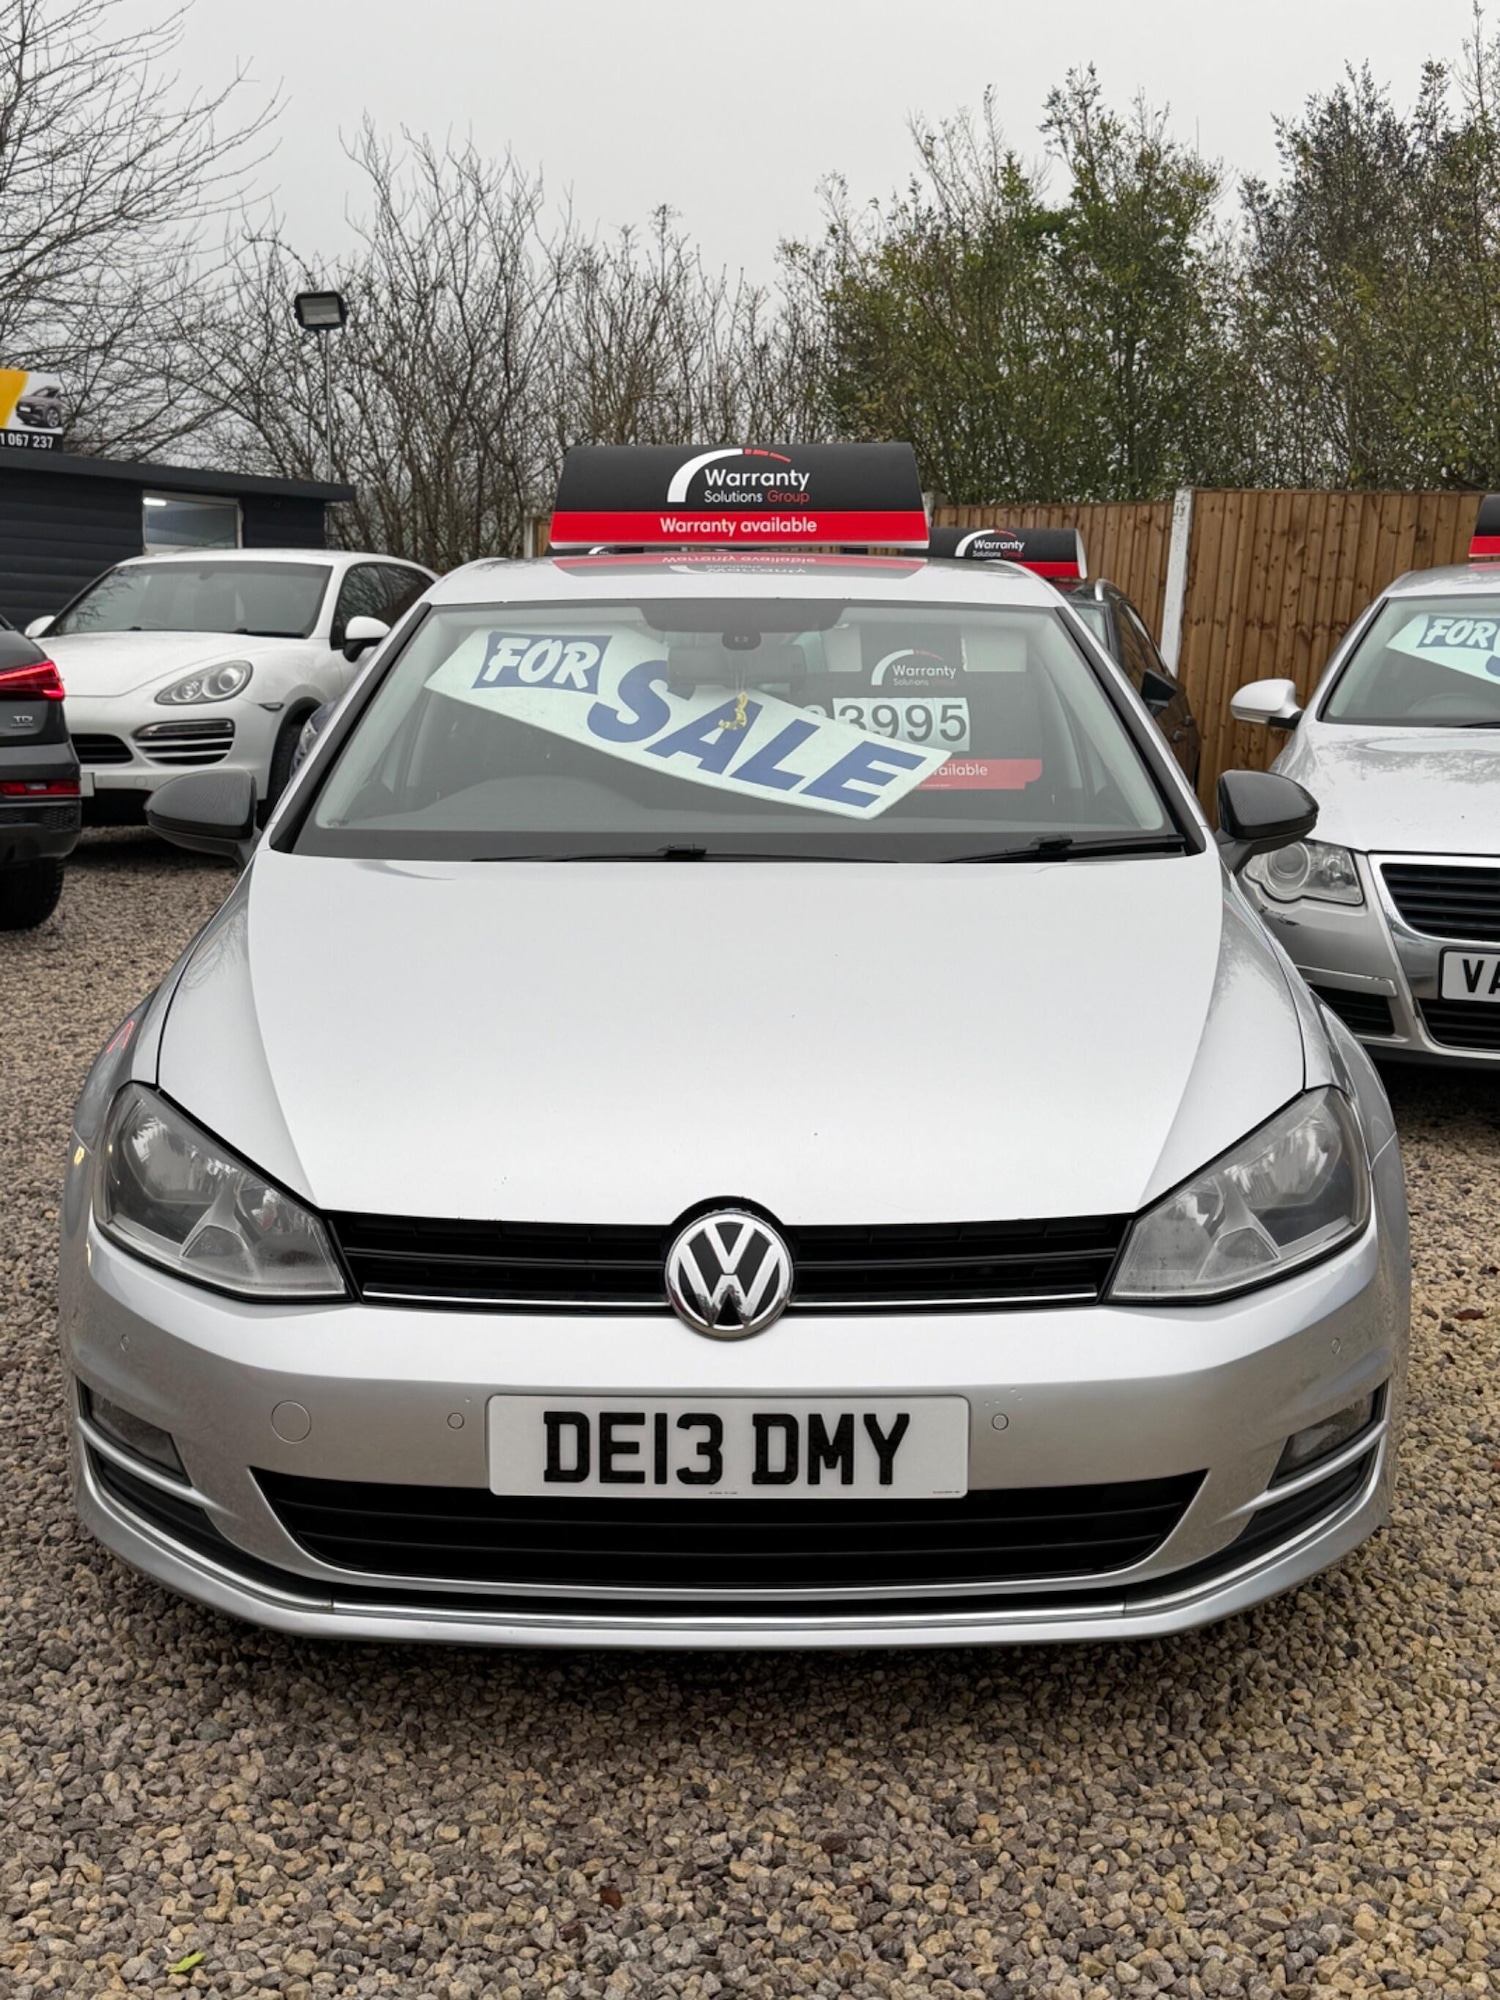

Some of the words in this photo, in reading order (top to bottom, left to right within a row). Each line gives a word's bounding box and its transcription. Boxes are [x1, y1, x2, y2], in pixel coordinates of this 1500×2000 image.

[7, 432, 29, 447] 067
[32, 435, 54, 449] 237
[704, 469, 811, 491] Warranty
[704, 490, 763, 503] Solutions
[767, 490, 811, 504] Group
[660, 517, 737, 537] Warranty
[740, 517, 818, 534] available
[972, 550, 1001, 558] Solutions
[974, 539, 1025, 552] Warranty
[1423, 618, 1497, 648] FOR
[482, 637, 600, 689] FOR
[892, 665, 956, 679] Warranty
[803, 703, 967, 742] 3995
[587, 659, 928, 808] SALE
[933, 763, 989, 776] ailable
[543, 1411, 724, 1485] DE13
[752, 1413, 911, 1486] DMY
